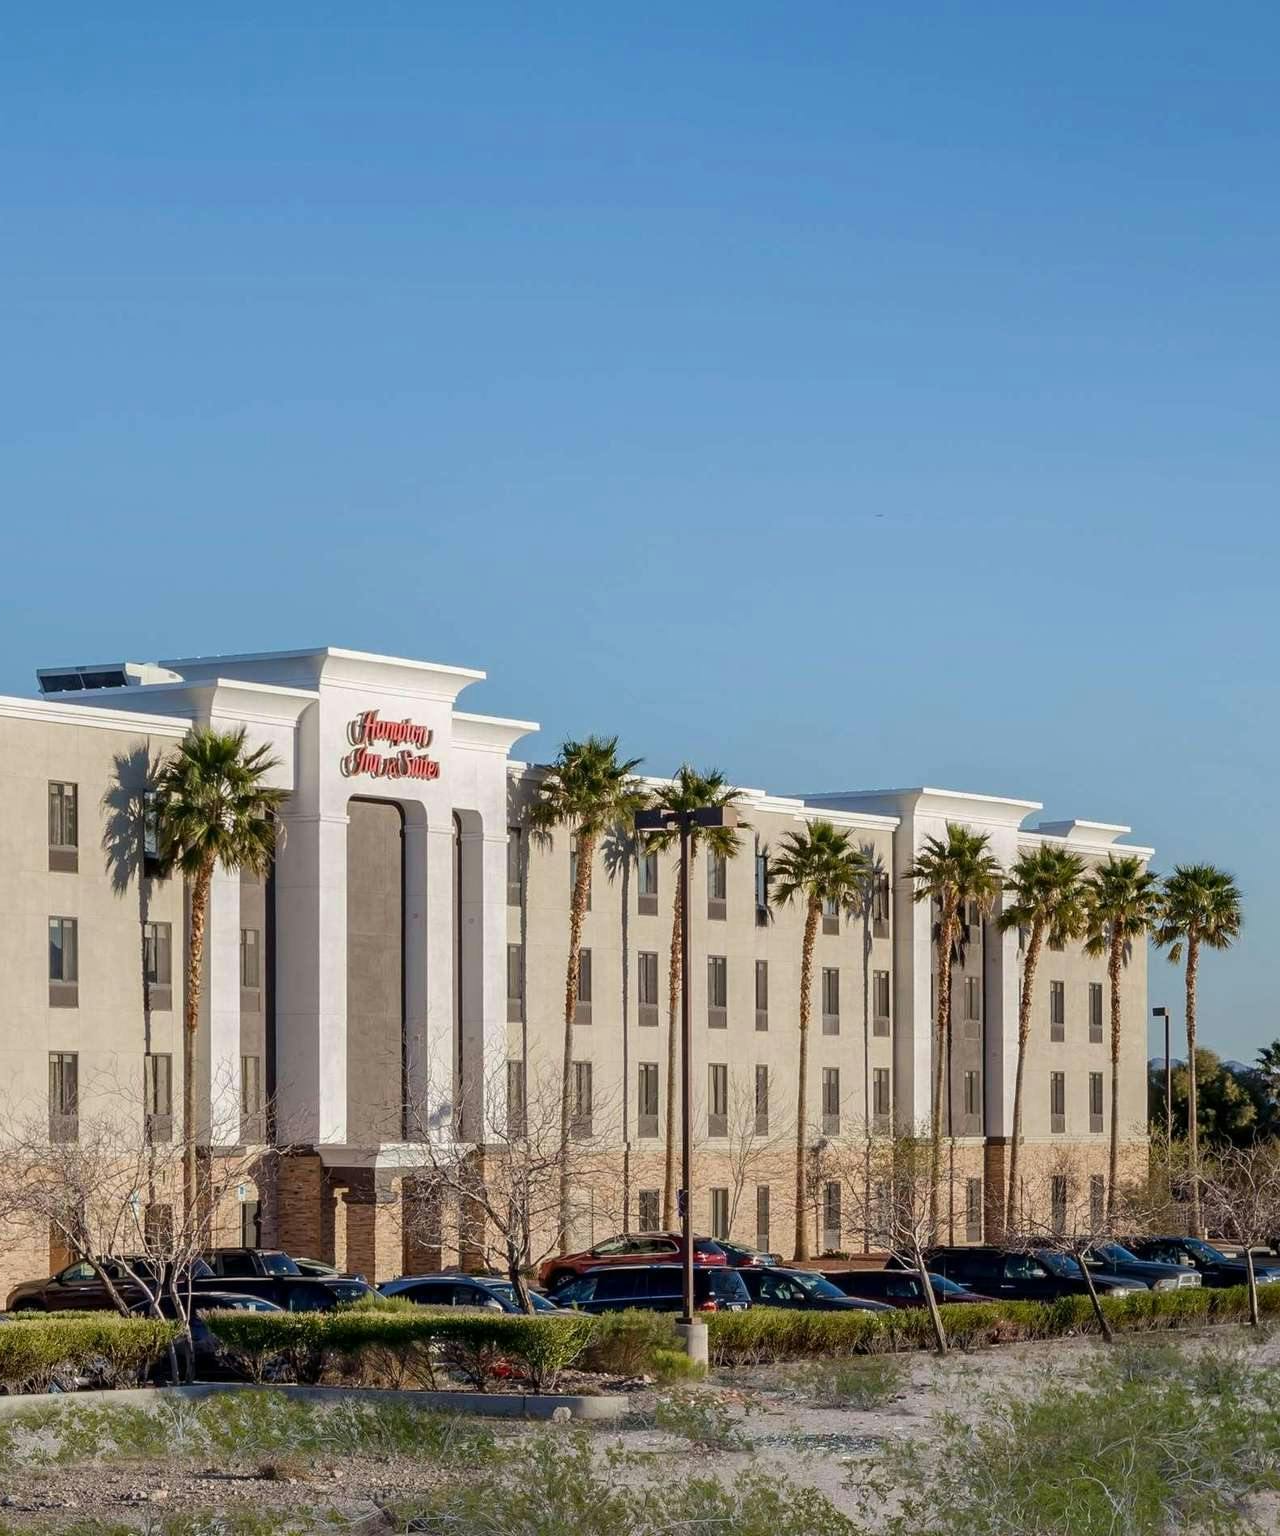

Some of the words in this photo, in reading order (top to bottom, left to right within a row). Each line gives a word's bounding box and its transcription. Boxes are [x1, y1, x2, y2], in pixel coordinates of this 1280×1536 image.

[347, 709, 433, 749] Hampton
[340, 747, 386, 779] Inn
[397, 750, 440, 780] Suites
